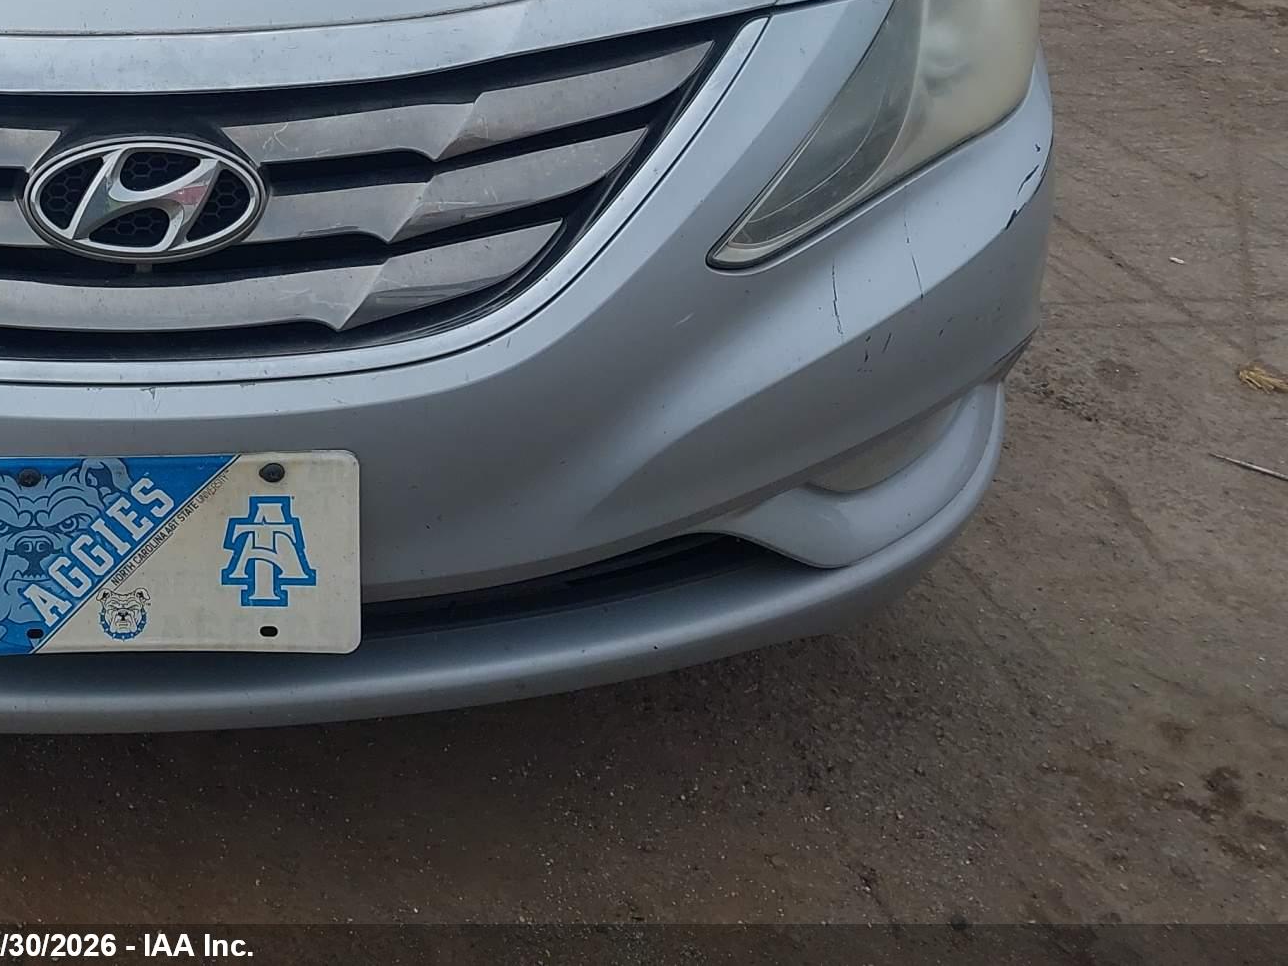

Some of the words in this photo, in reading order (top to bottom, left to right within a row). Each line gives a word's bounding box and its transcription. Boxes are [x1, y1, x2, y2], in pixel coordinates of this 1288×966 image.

[23, 477, 174, 627] AGGIES
[110, 561, 136, 586] NORTH
[133, 531, 168, 564] CAROLINA
[177, 501, 200, 523] STATE
